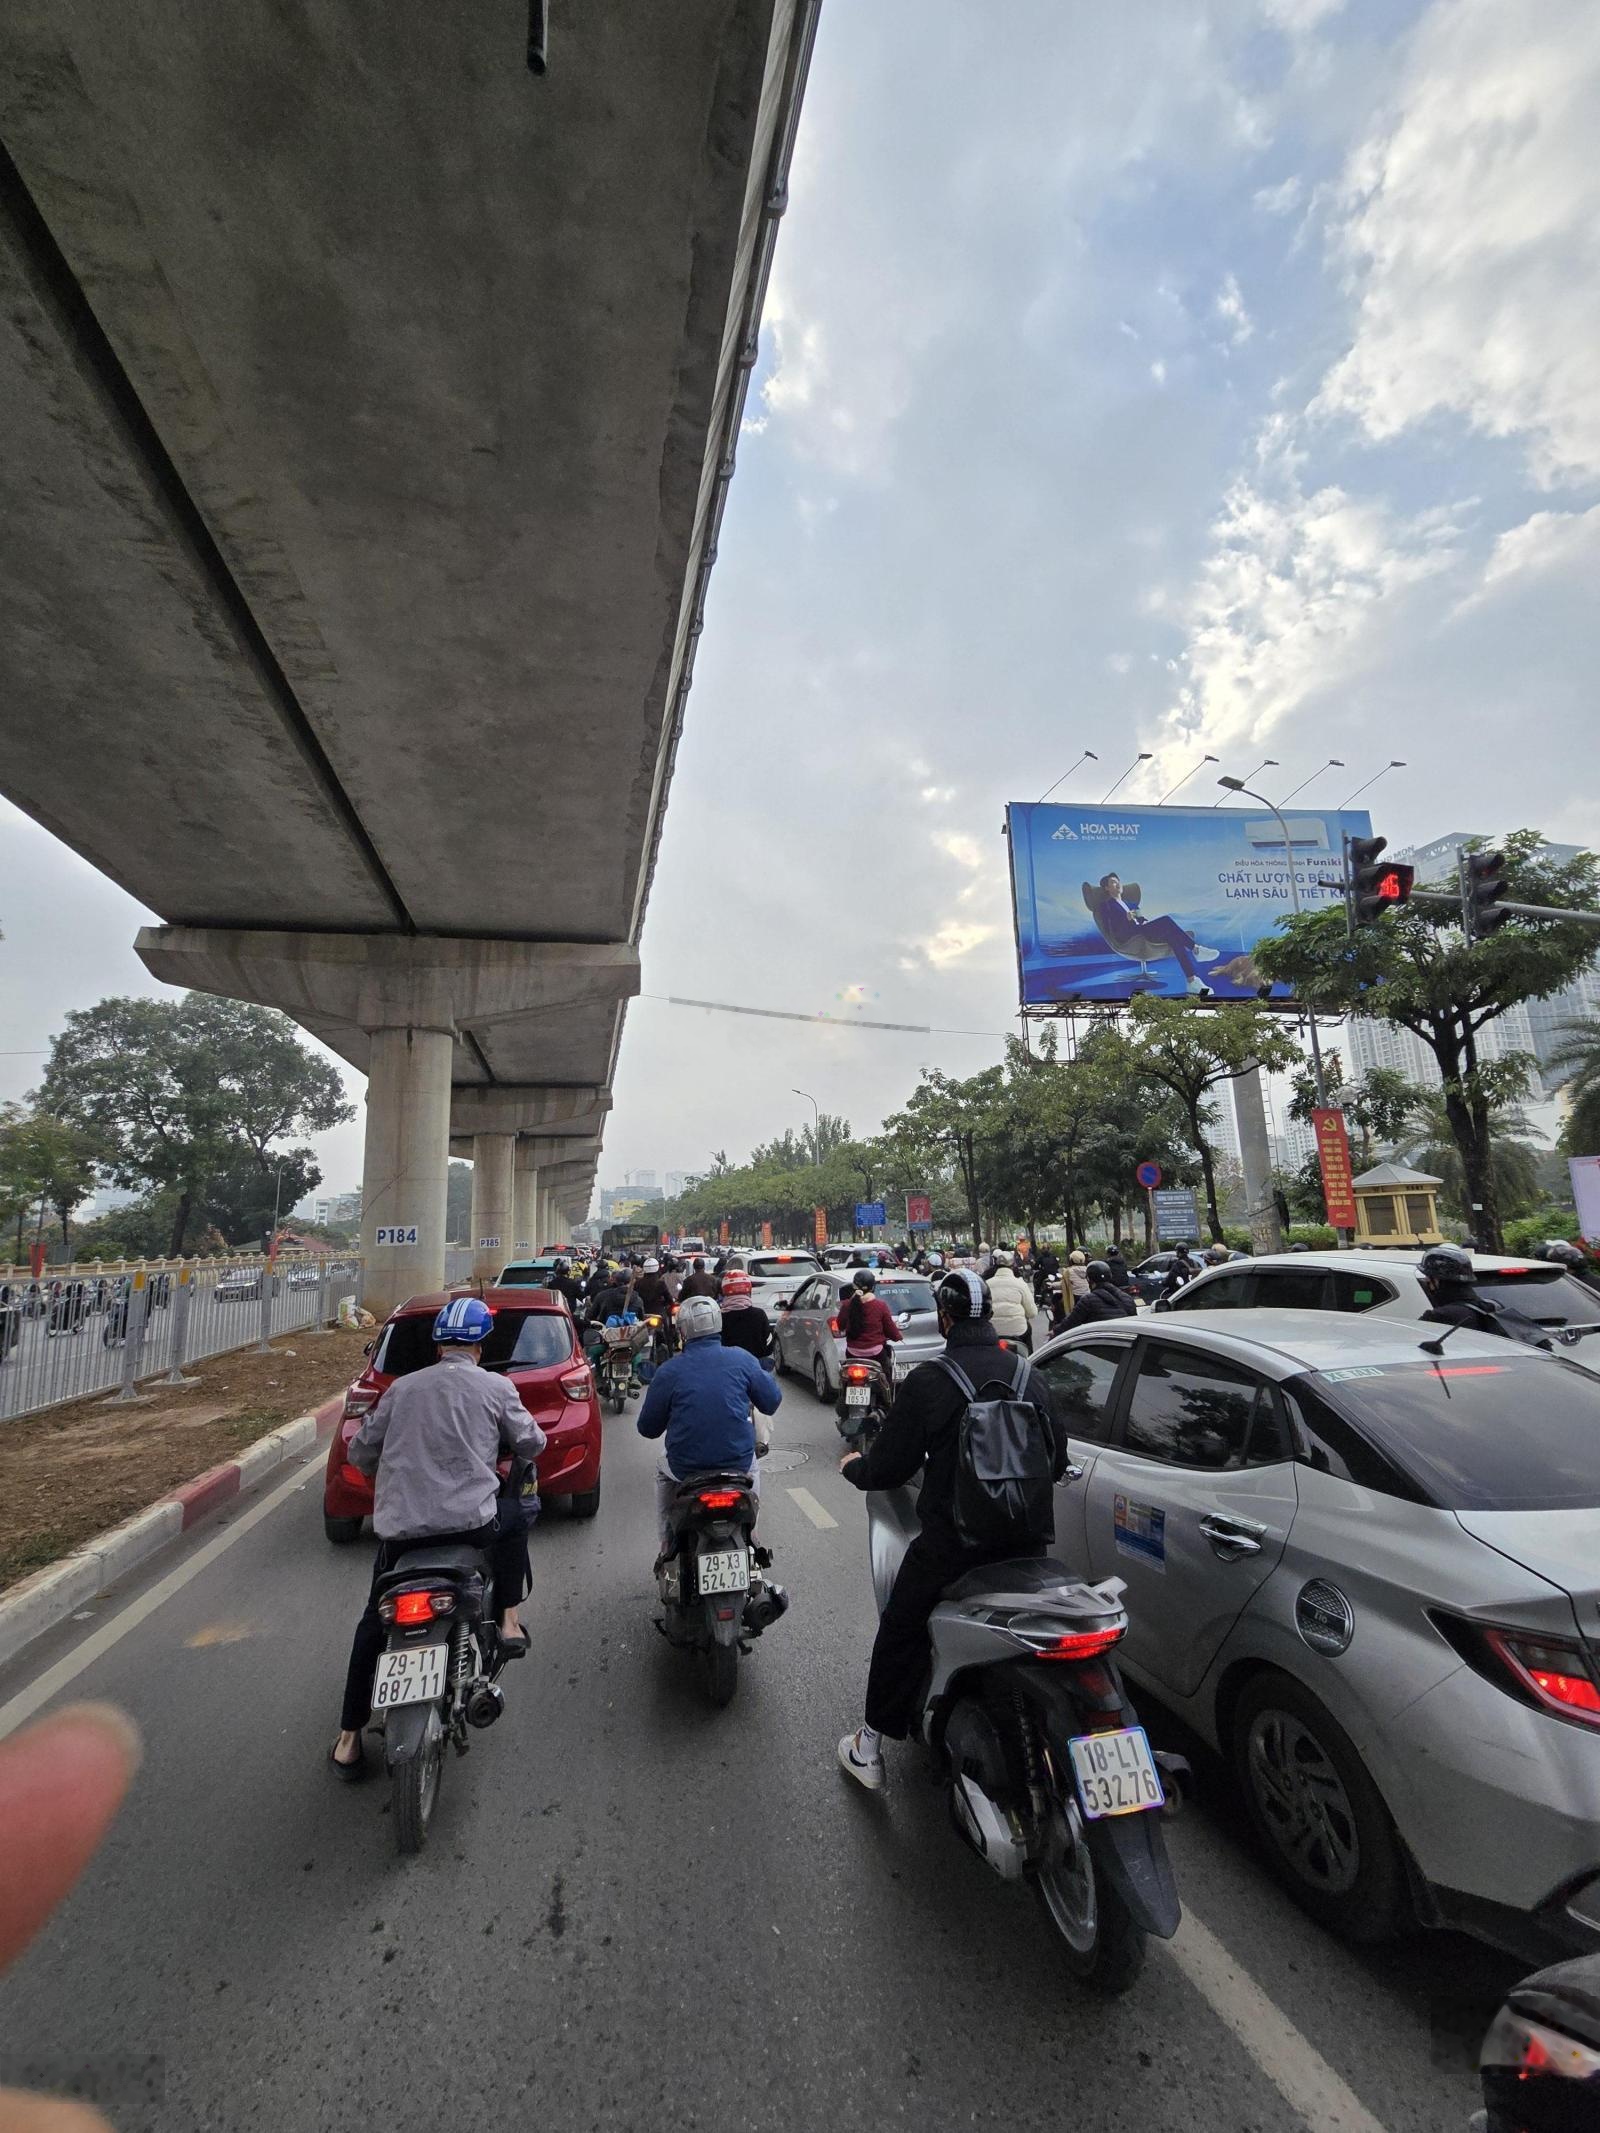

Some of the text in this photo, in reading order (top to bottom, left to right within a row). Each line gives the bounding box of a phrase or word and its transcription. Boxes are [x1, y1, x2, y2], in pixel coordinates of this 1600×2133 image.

[1306, 858, 1342, 866] Funiki
[1218, 869, 1252, 884] CHẤT
[1226, 888, 1260, 900] LẠNH
[1262, 886, 1289, 899] SÂU
[377, 1228, 417, 1244] P184
[480, 1238, 499, 1247] P185
[705, 1553, 741, 1573] 29-X3
[702, 1570, 746, 1592] 524.28
[386, 1649, 436, 1678] 29-T1
[378, 1672, 439, 1704] 887.11
[1083, 1735, 1140, 1773] 18-L1
[1082, 1768, 1158, 1812] 532.76
